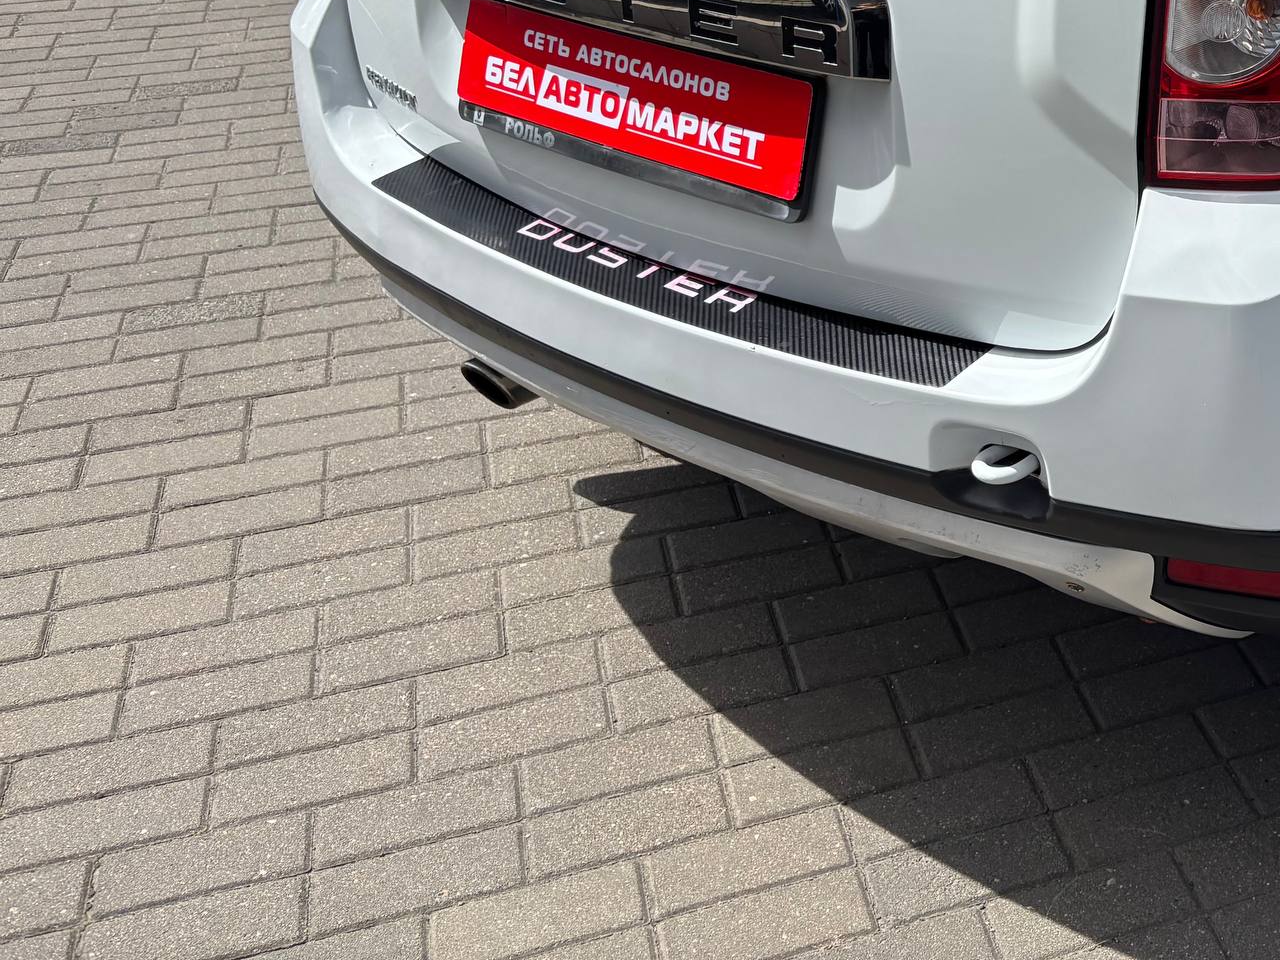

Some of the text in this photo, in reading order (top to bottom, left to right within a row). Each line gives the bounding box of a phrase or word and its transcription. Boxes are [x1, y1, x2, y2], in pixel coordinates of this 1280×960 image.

[524, 29, 732, 102] СЕТЬ АВТОСАЛОНОВ
[505, 116, 555, 148] РОЛЬФ
[516, 218, 759, 313] DUSTER
